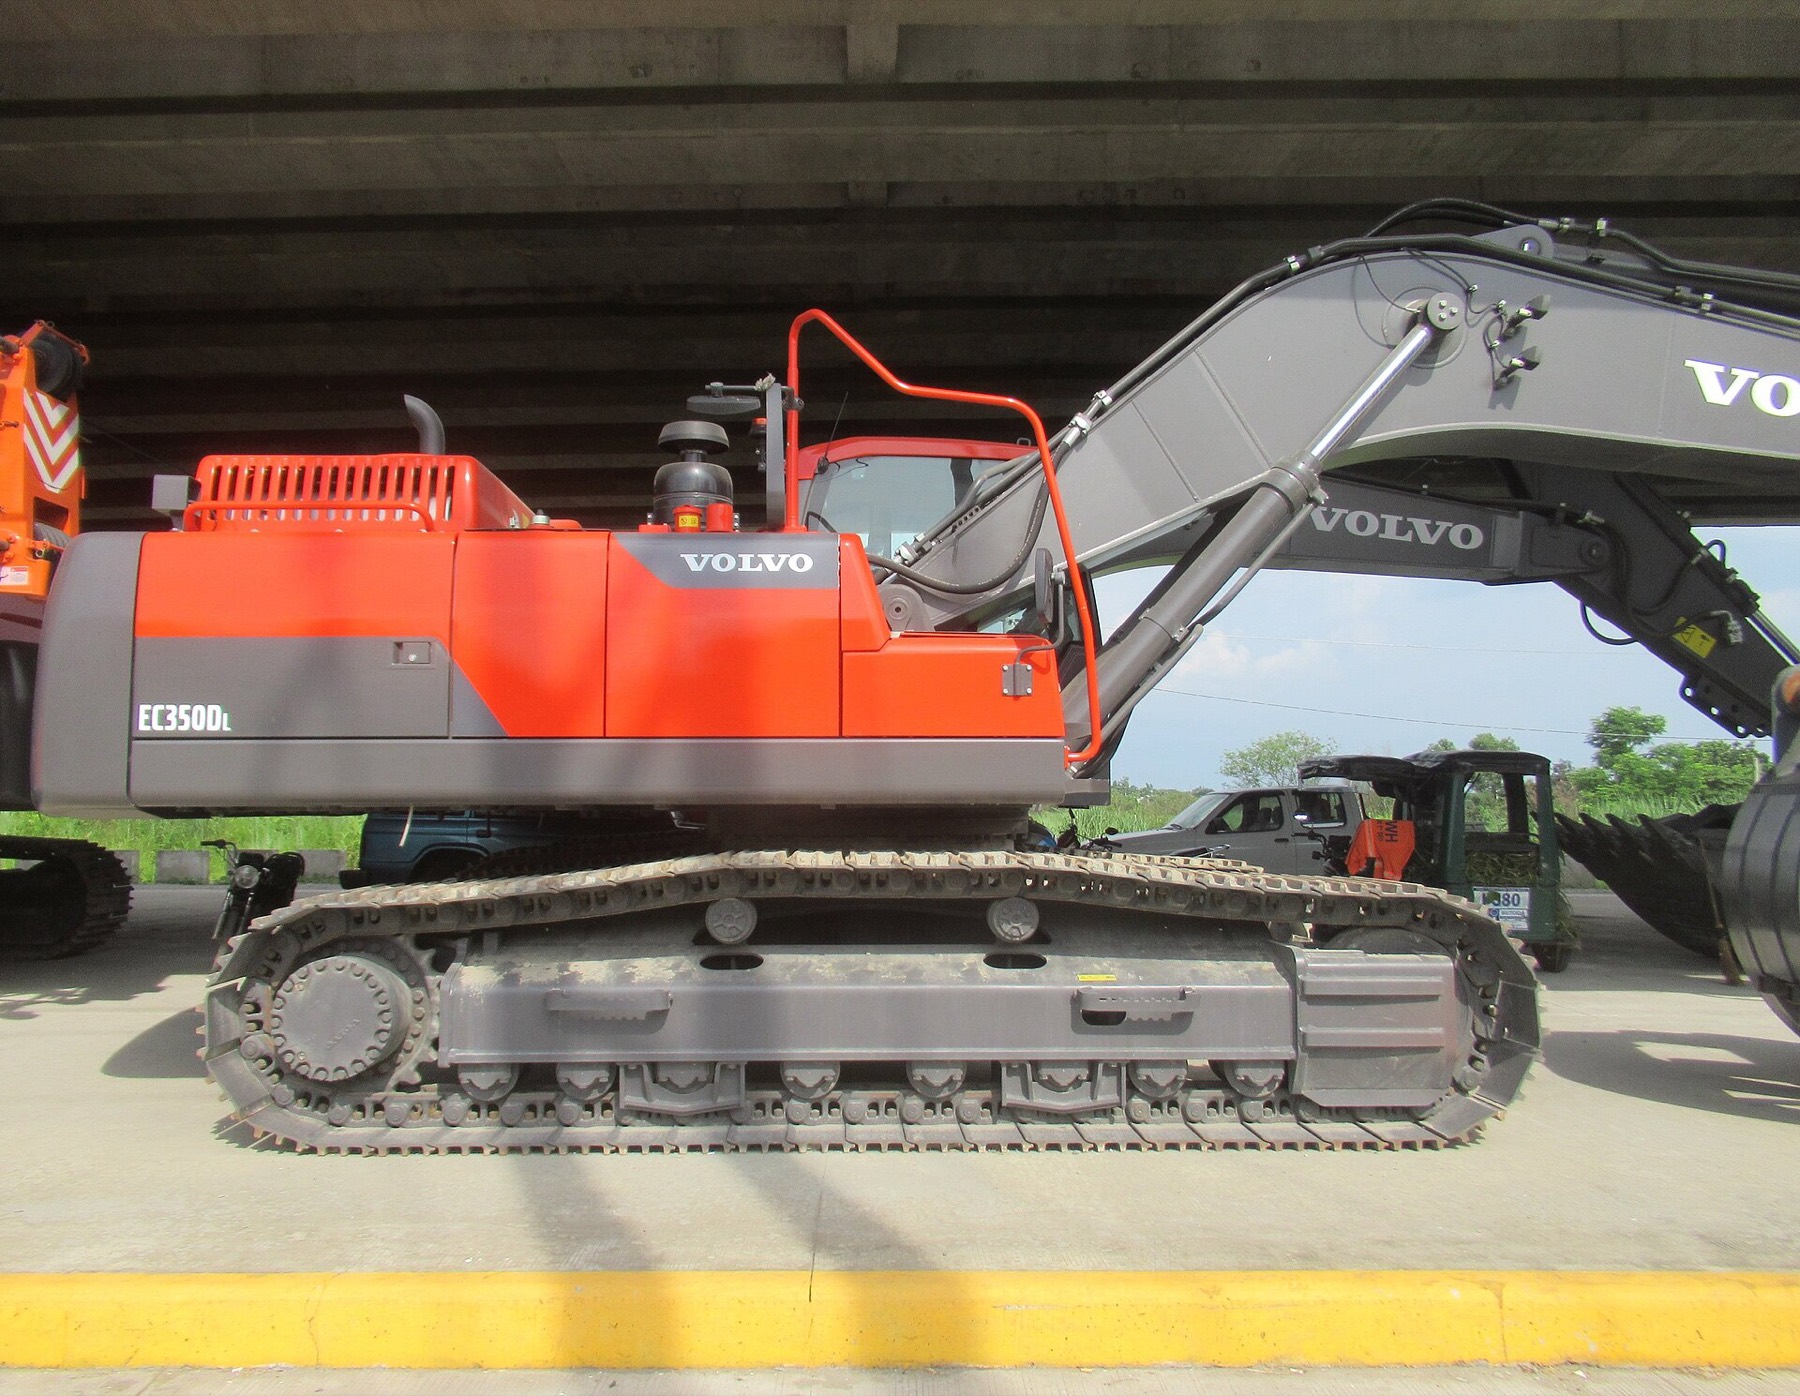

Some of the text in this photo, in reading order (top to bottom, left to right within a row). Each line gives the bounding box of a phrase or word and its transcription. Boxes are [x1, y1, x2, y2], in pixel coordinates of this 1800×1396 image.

[1684, 359, 1800, 417] VO
[1310, 506, 1484, 549] VOLVO
[680, 553, 814, 572] VOLVO
